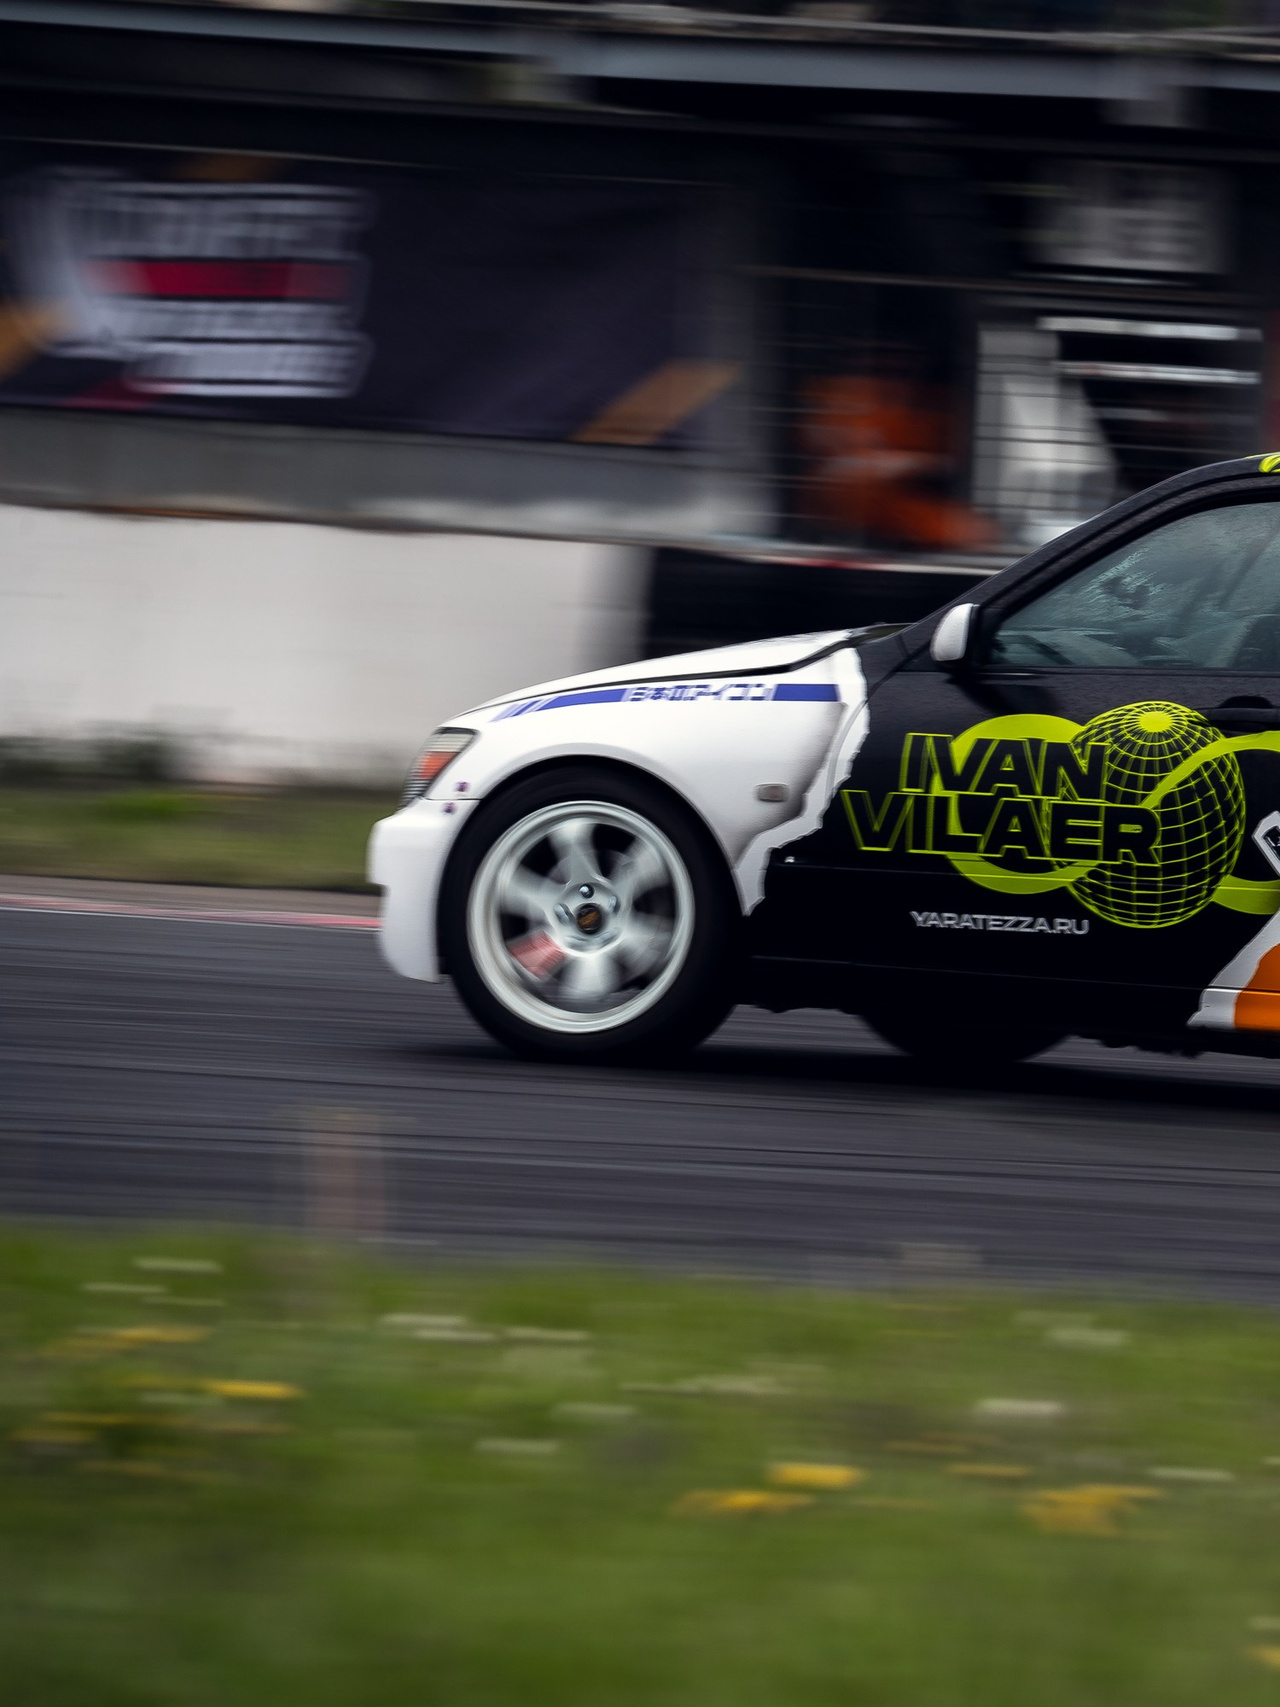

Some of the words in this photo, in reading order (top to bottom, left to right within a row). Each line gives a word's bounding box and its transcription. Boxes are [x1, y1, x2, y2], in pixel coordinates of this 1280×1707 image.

[899, 732, 1111, 802] IVAN
[840, 789, 1162, 867] VILAER
[908, 910, 1090, 935] YARATEZZA.RU
